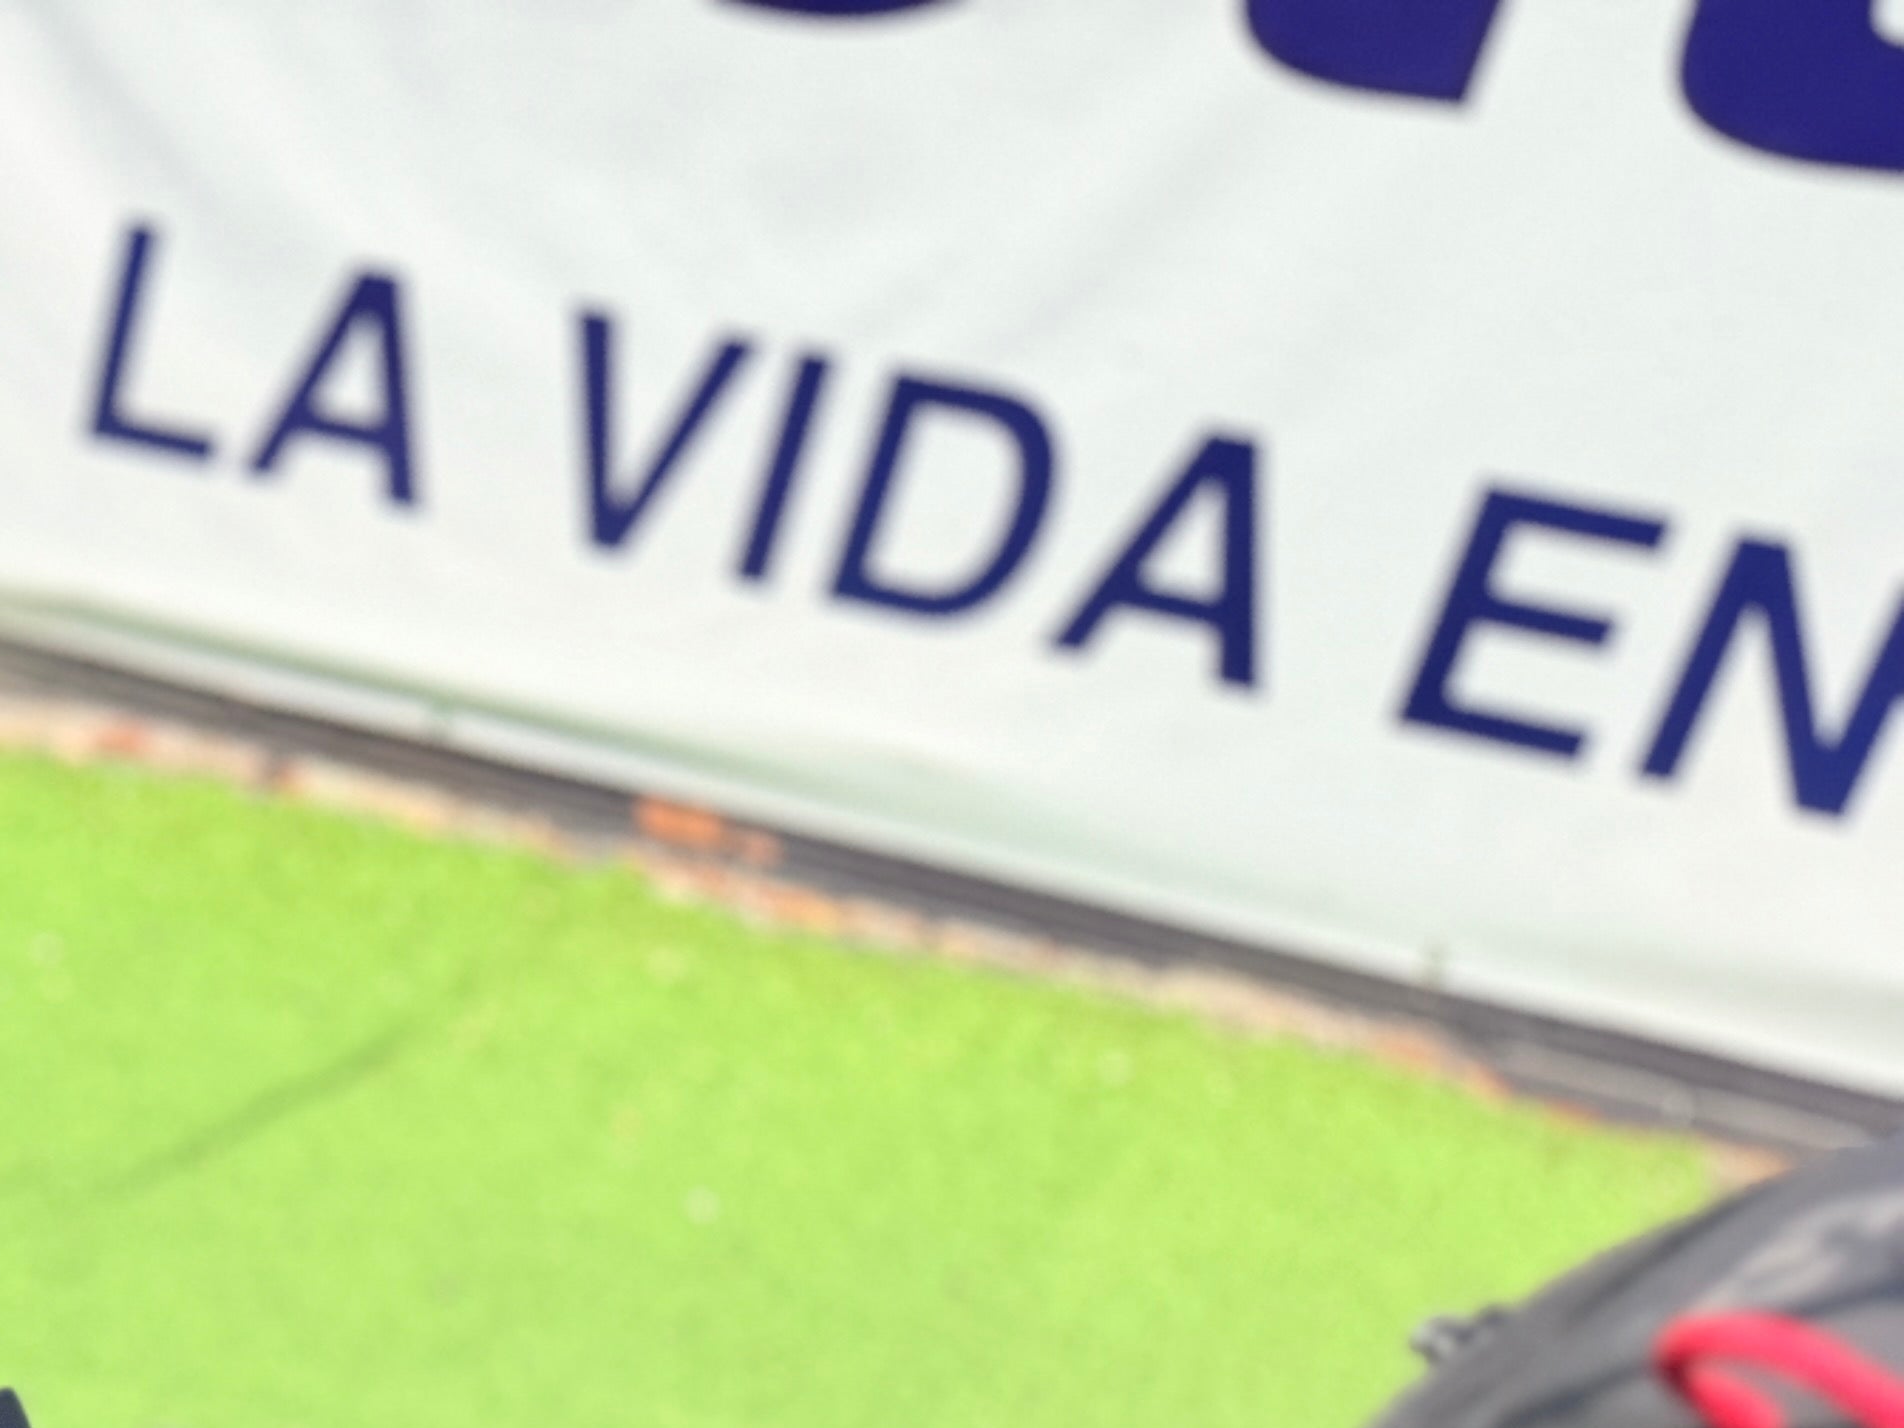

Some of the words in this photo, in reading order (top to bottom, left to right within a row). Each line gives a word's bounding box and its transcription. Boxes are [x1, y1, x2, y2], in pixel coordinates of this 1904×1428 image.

[89, 223, 422, 510] LA
[576, 309, 1260, 692] VIDA
[1397, 484, 1904, 820] EN
